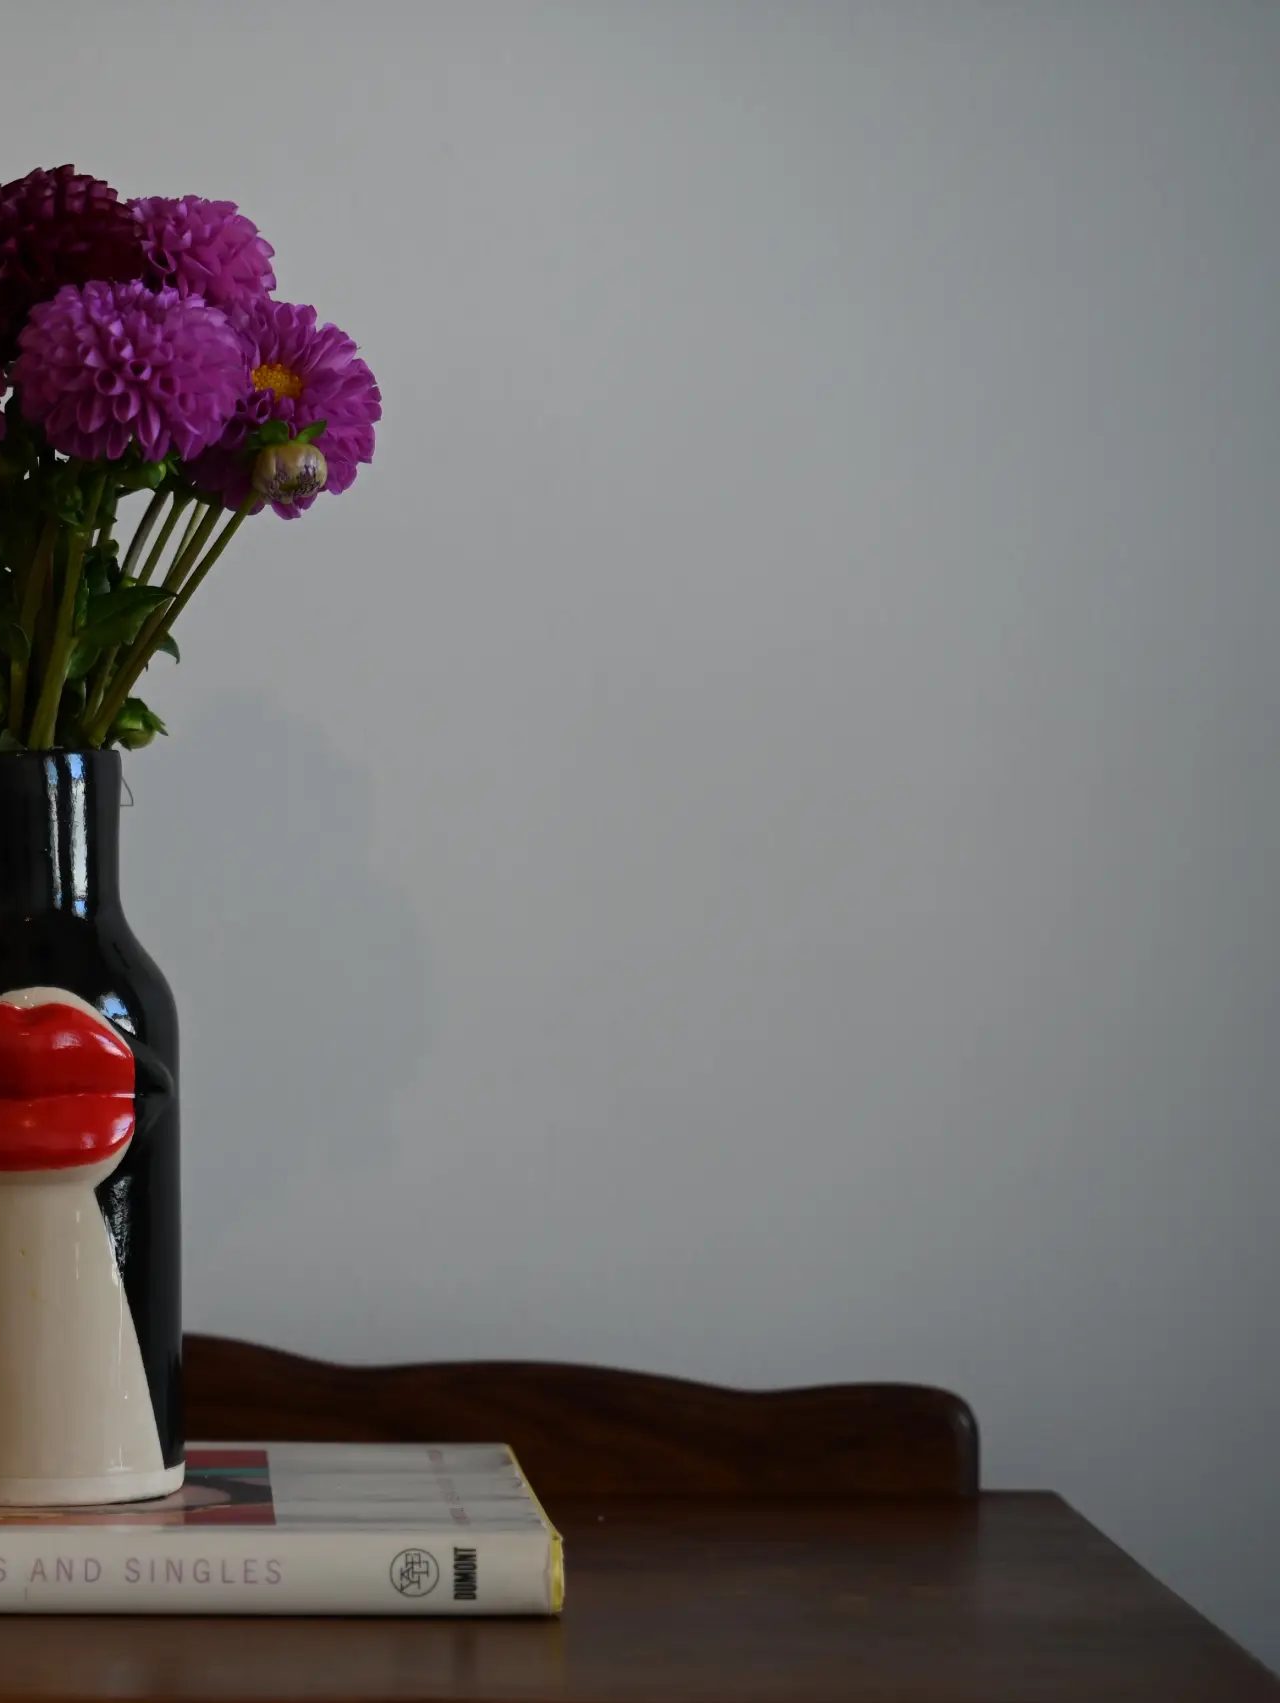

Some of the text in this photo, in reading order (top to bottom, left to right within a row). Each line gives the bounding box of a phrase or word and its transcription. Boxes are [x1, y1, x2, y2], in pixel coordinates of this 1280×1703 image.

[29, 1557, 102, 1584] AND
[124, 1557, 282, 1585] SINGLES
[453, 1546, 477, 1600] DUMONT
